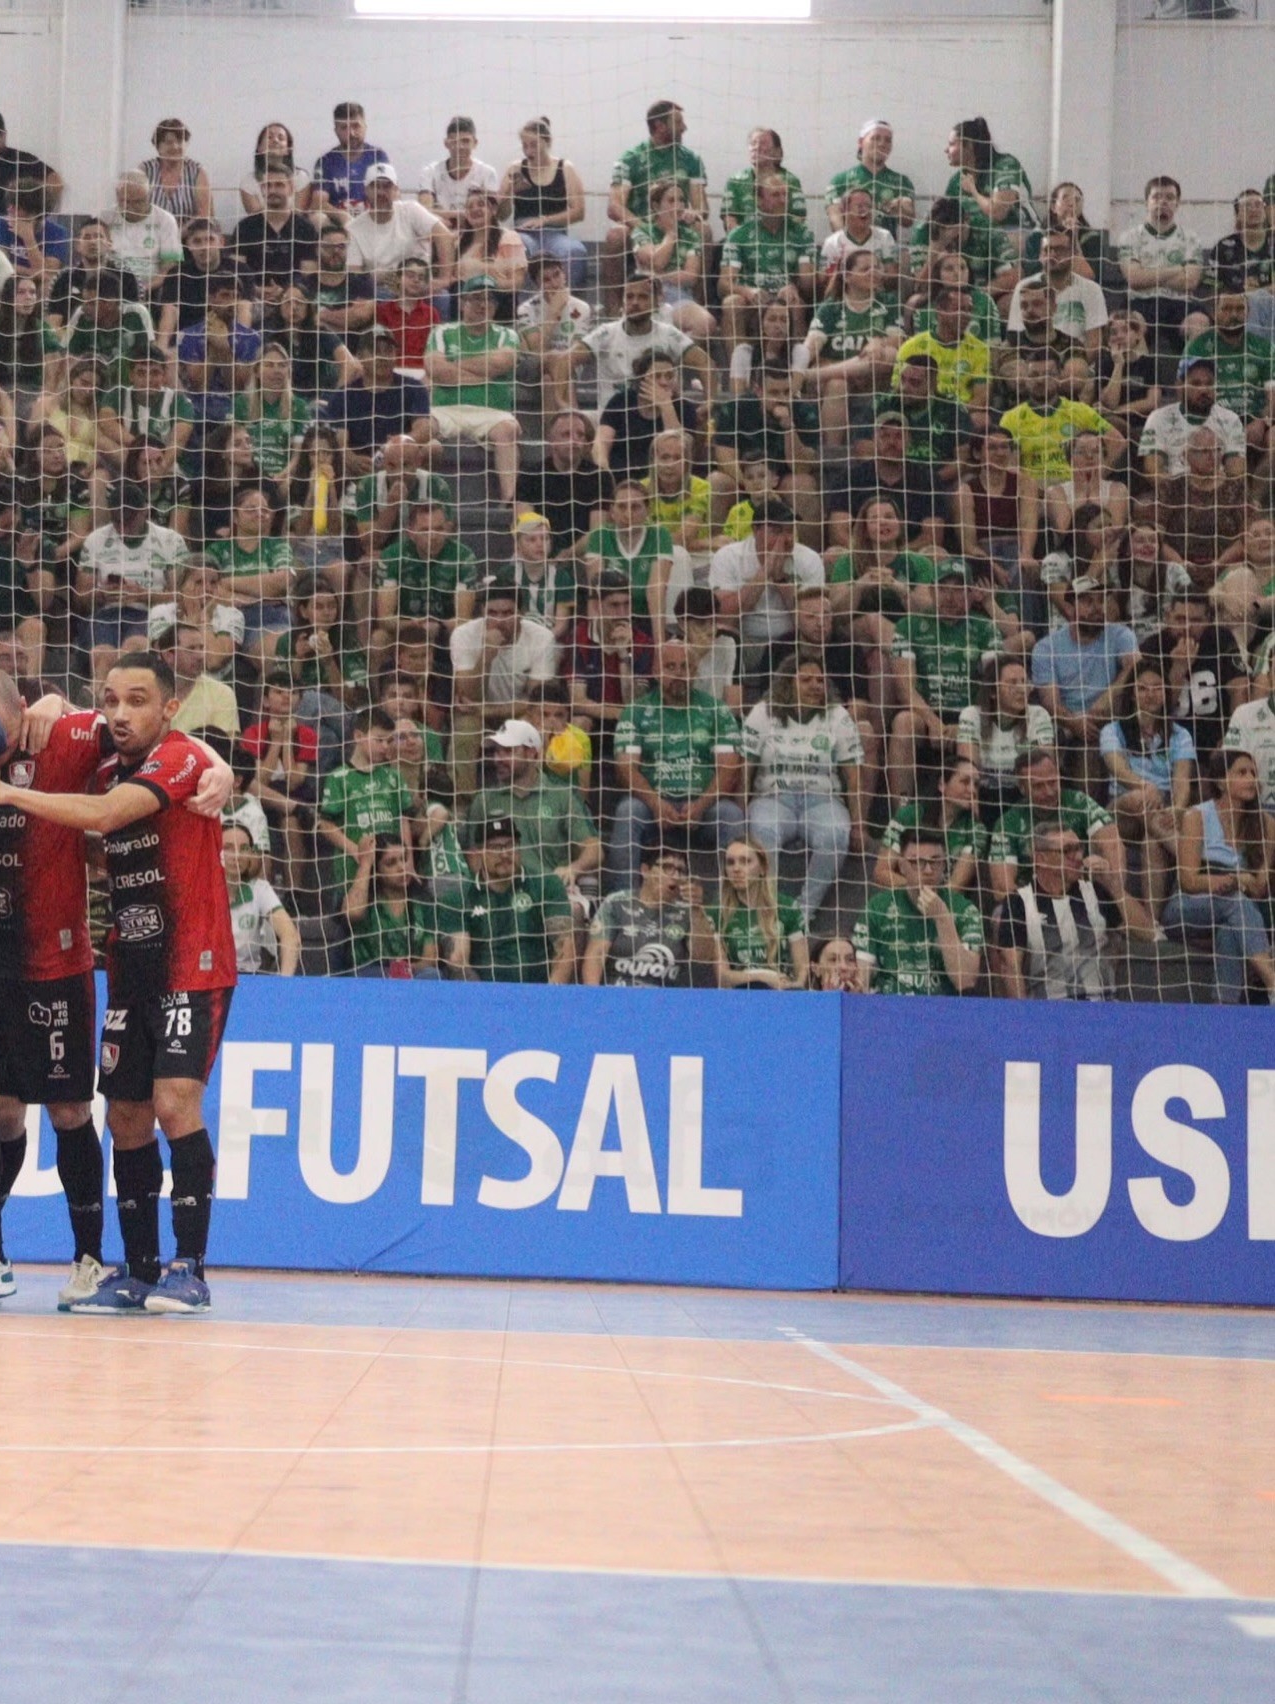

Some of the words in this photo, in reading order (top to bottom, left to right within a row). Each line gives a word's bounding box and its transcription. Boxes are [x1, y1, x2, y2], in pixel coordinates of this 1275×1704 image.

[115, 867, 166, 890] CRESOL
[165, 1008, 192, 1037] 78
[49, 1030, 65, 1061] 6
[214, 1041, 743, 1218] FUTSAL
[1003, 1061, 1275, 1242] US
